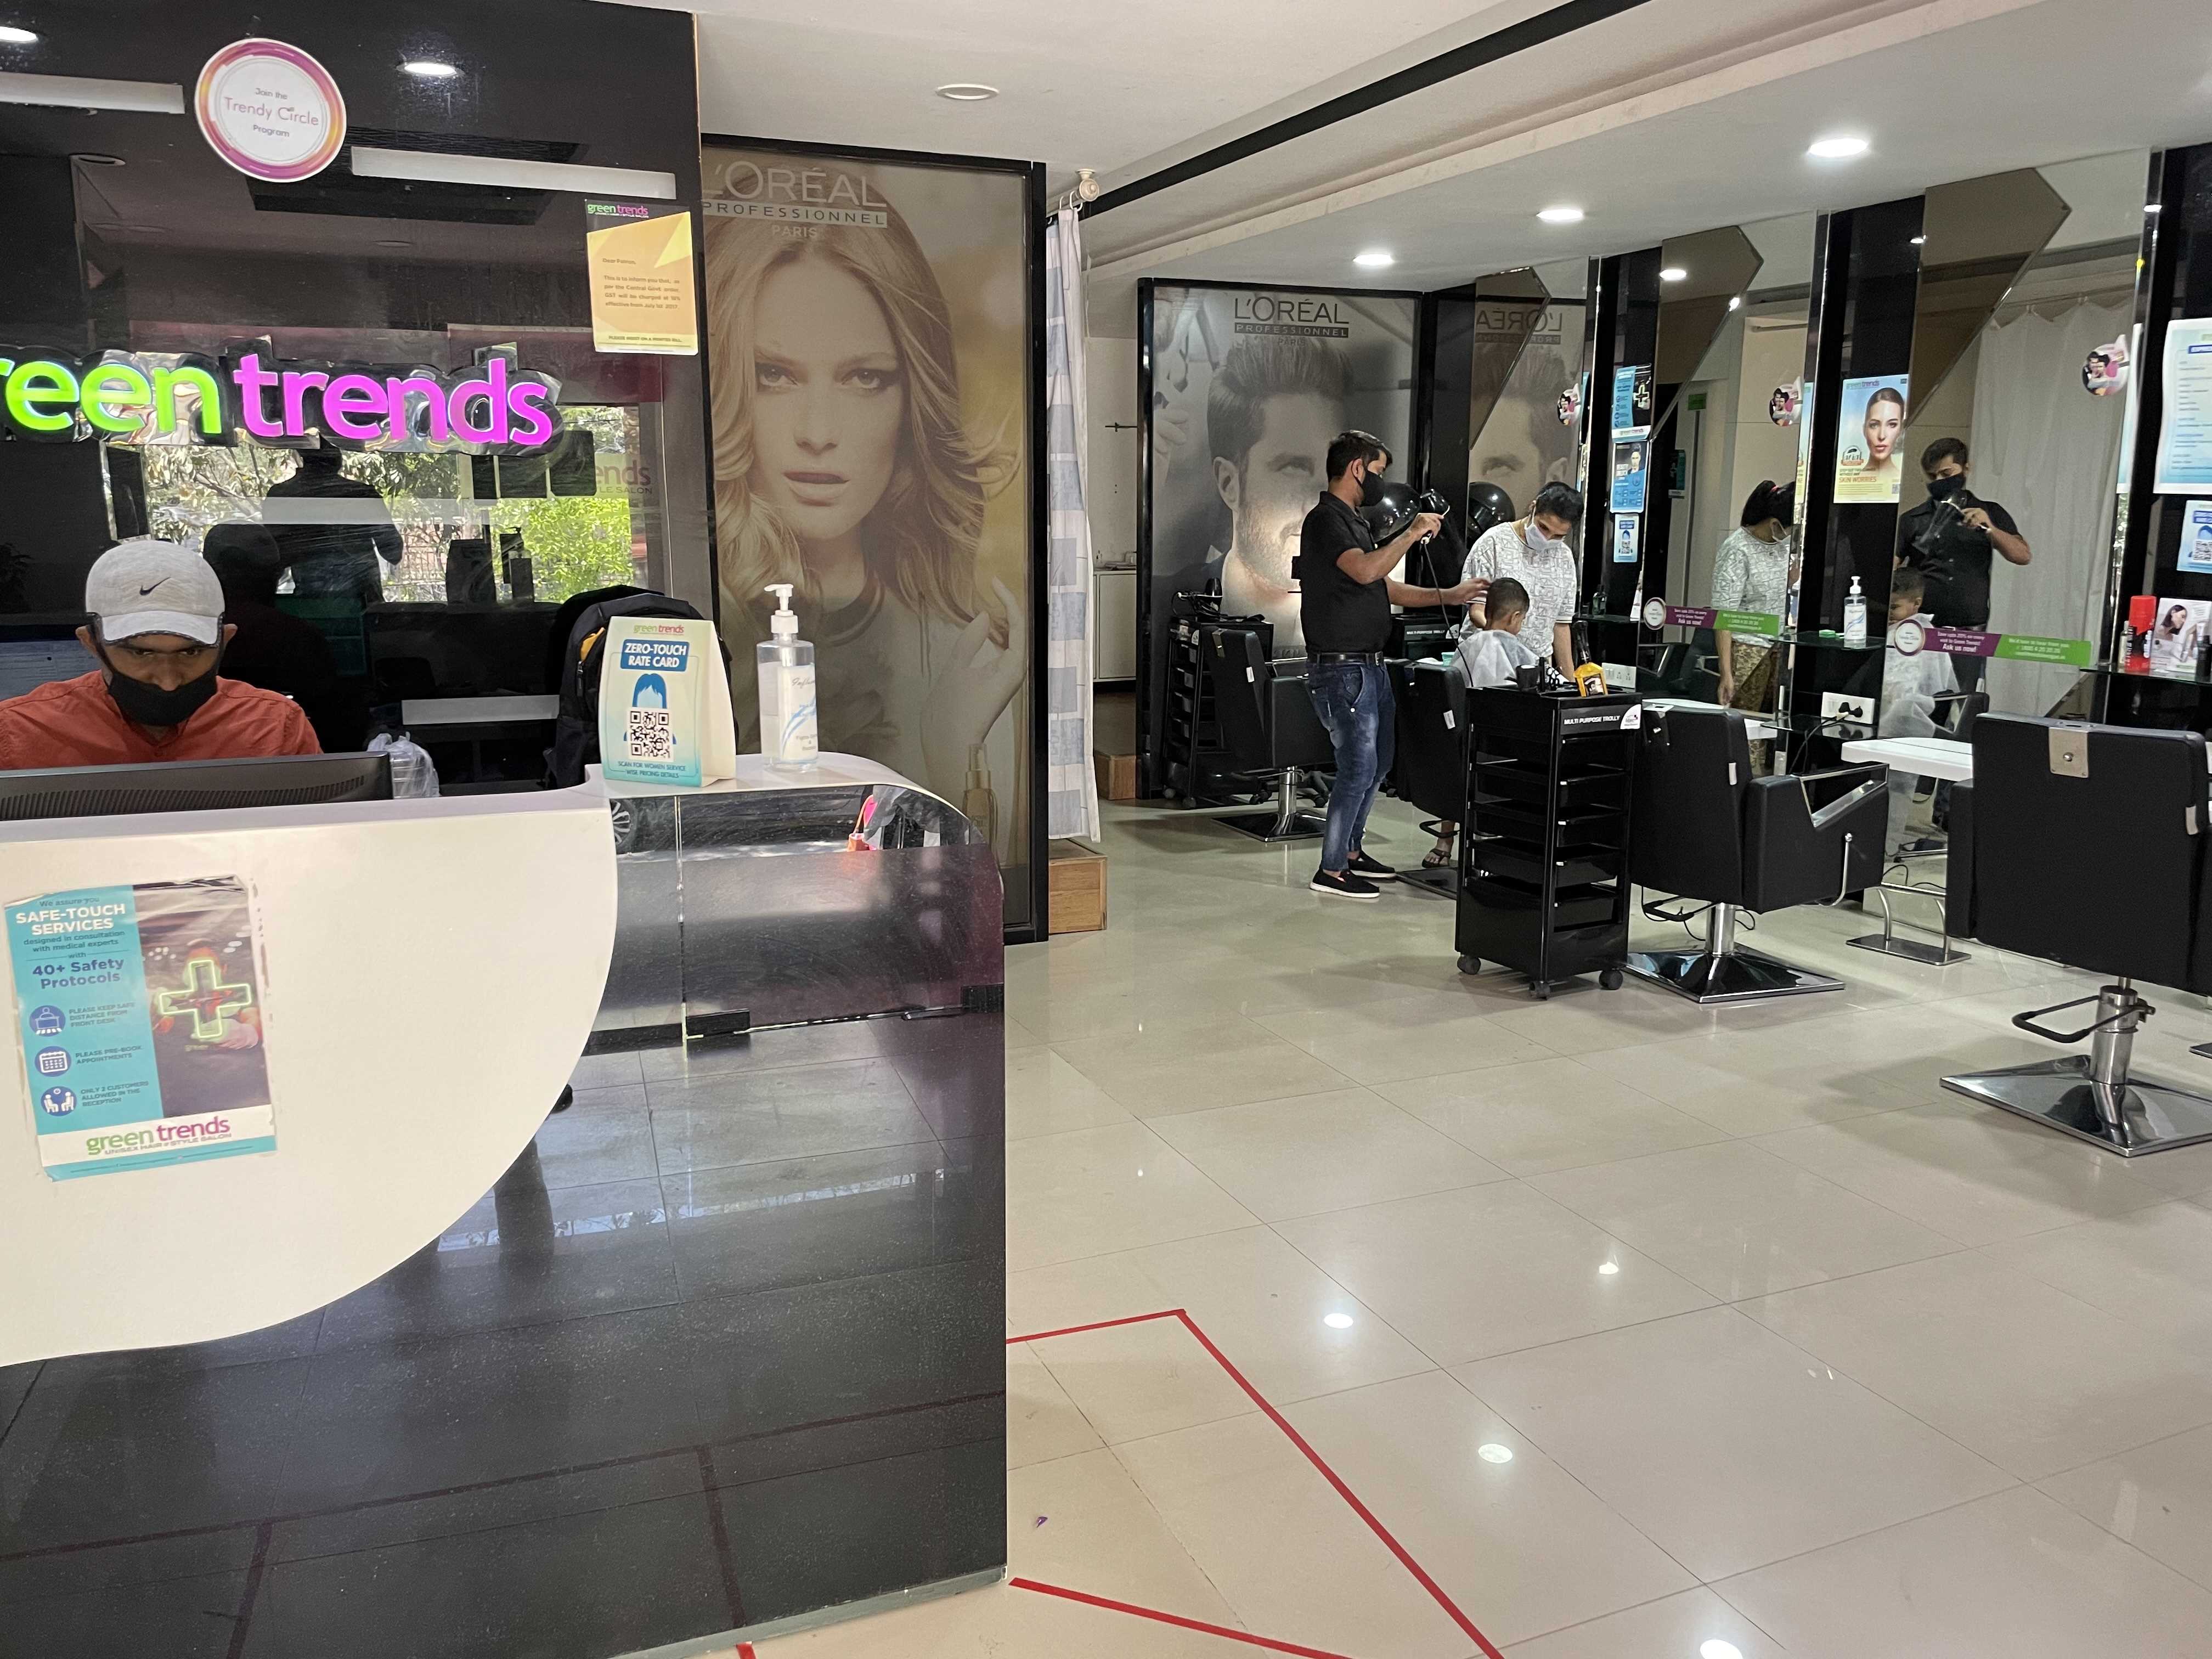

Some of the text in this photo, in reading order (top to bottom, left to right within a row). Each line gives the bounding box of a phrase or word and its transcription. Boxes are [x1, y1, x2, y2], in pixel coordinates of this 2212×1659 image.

[255, 88, 273, 97] Join
[224, 97, 319, 126] Trendy Circle
[253, 125, 290, 137] Program
[588, 204, 616, 214] green
[617, 205, 648, 215] trends
[771, 225, 818, 239] PARIS
[1235, 296, 1350, 324] L'ORÉAL
[1237, 324, 1347, 337] PROFESSIONNEL
[1278, 337, 1306, 346] PARIS
[233, 353, 553, 445] trends
[634, 624, 684, 633] green trends
[624, 642, 687, 656] ZERO-TOUCH
[628, 655, 680, 668] RATE CARD
[82, 896, 100, 906] you
[16, 904, 126, 924] SAFE-TOUCH
[31, 918, 114, 935] SERVICES
[24, 935, 61, 946] designed
[74, 930, 126, 940] consultation
[53, 941, 86, 951] medical
[88, 939, 119, 949] experts
[32, 958, 125, 976] 40+ Safety
[41, 971, 121, 989] Protocols
[69, 1006, 96, 1014] PLEASE
[70, 1012, 105, 1021] DISTANCE
[104, 1045, 142, 1054] PRE-BOOK
[77, 1053, 132, 1064] APPOINTMENTS
[107, 1081, 149, 1091] CUSTOMERS
[82, 1091, 117, 1101] ALLOWED
[82, 1097, 122, 1107] RECEPTION
[86, 1116, 231, 1155] green trends
[104, 1146, 138, 1155] UNISEX
[140, 1142, 162, 1150] HAIR
[170, 1137, 198, 1147] STYLE
[200, 1133, 232, 1142] SALON
